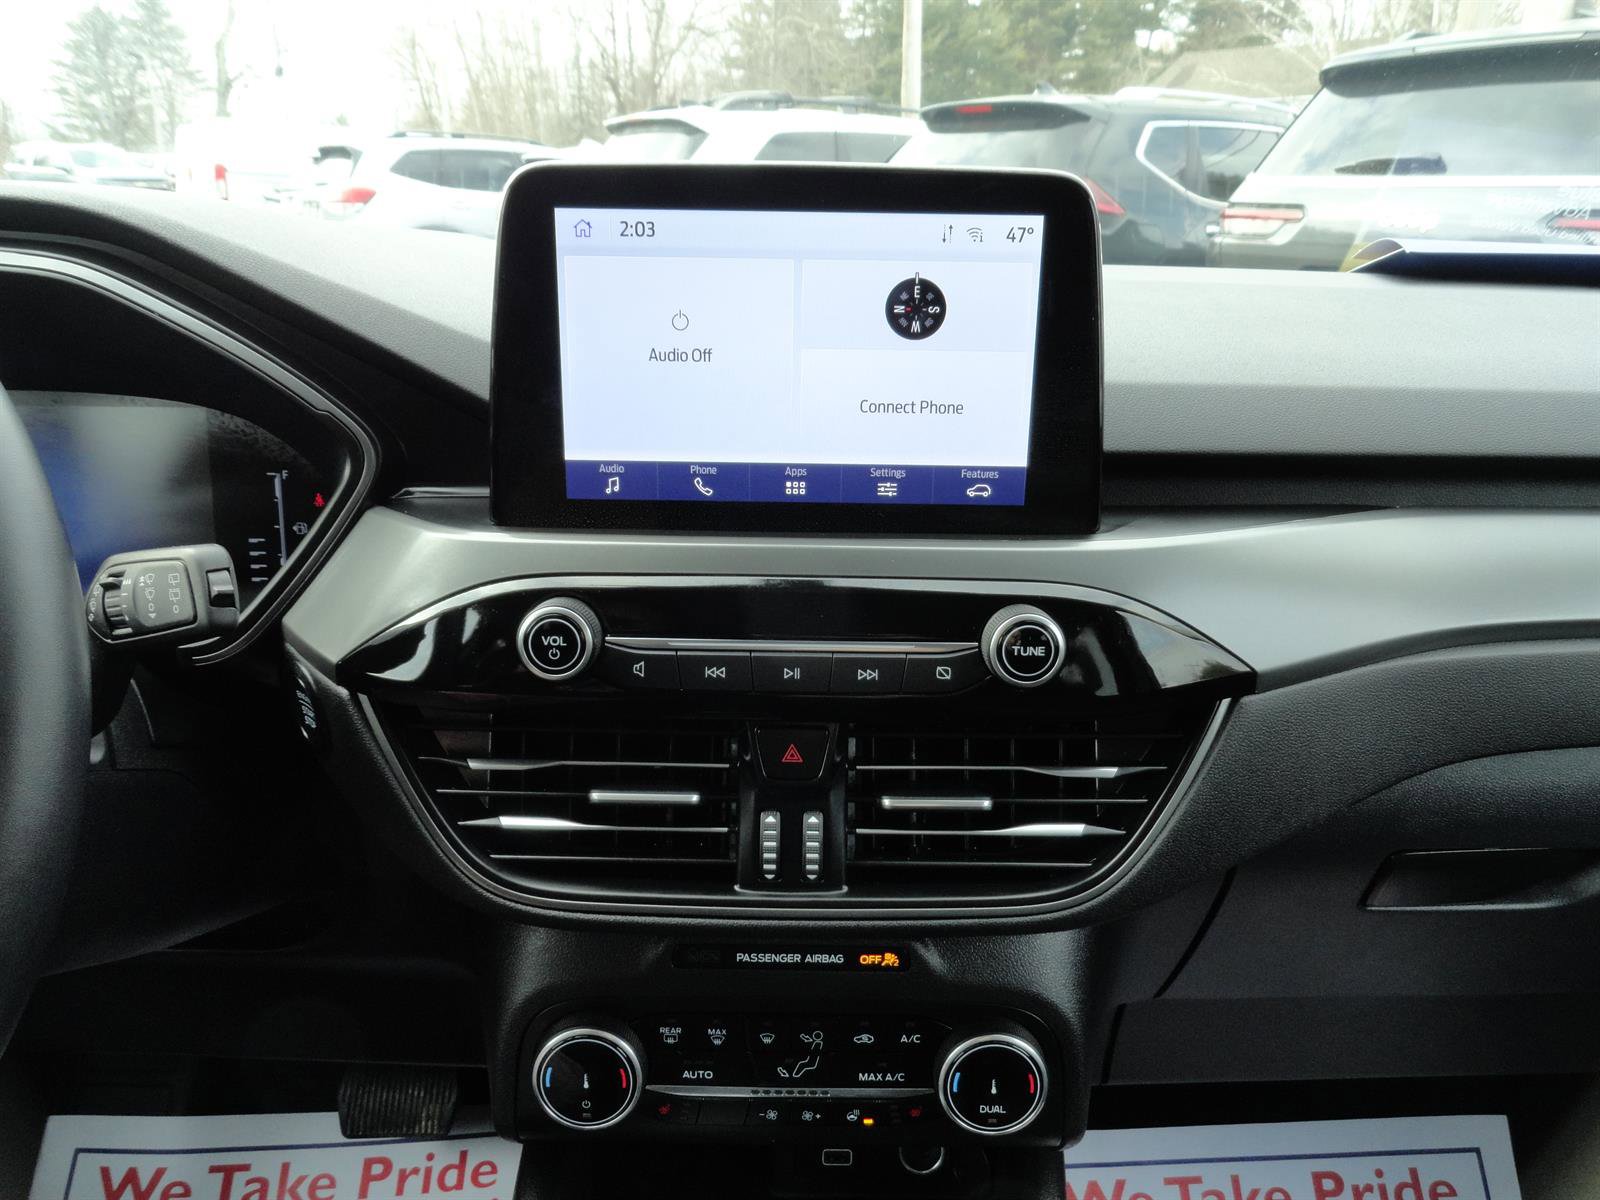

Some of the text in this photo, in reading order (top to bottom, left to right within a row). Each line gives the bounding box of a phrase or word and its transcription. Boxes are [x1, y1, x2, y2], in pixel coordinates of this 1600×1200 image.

[619, 221, 656, 238] 2:03
[1006, 226, 1034, 243] 47°
[914, 285, 921, 298] E
[893, 305, 905, 313] N
[910, 320, 921, 333] W
[648, 347, 713, 363] Audio Off
[859, 399, 964, 415] Connect Phone
[599, 463, 625, 474] Audio
[690, 464, 718, 475] Phone
[785, 466, 807, 478] Apps
[870, 467, 906, 479] Settings
[961, 468, 999, 479] Features
[541, 635, 567, 646] VOL
[1012, 645, 1046, 657] TUNE
[736, 952, 845, 964] PASSENGER AIRBAG
[859, 954, 882, 965] OFF
[659, 1027, 682, 1036] REAR
[707, 1028, 727, 1036] MAX
[900, 1034, 921, 1044] A/C
[682, 1070, 714, 1079] AUTO
[858, 1073, 905, 1082] MAX A/C
[979, 1105, 1007, 1114] DUAL
[100, 1150, 498, 1200] We Take Pride
[1311, 1167, 1457, 1200] Pride
